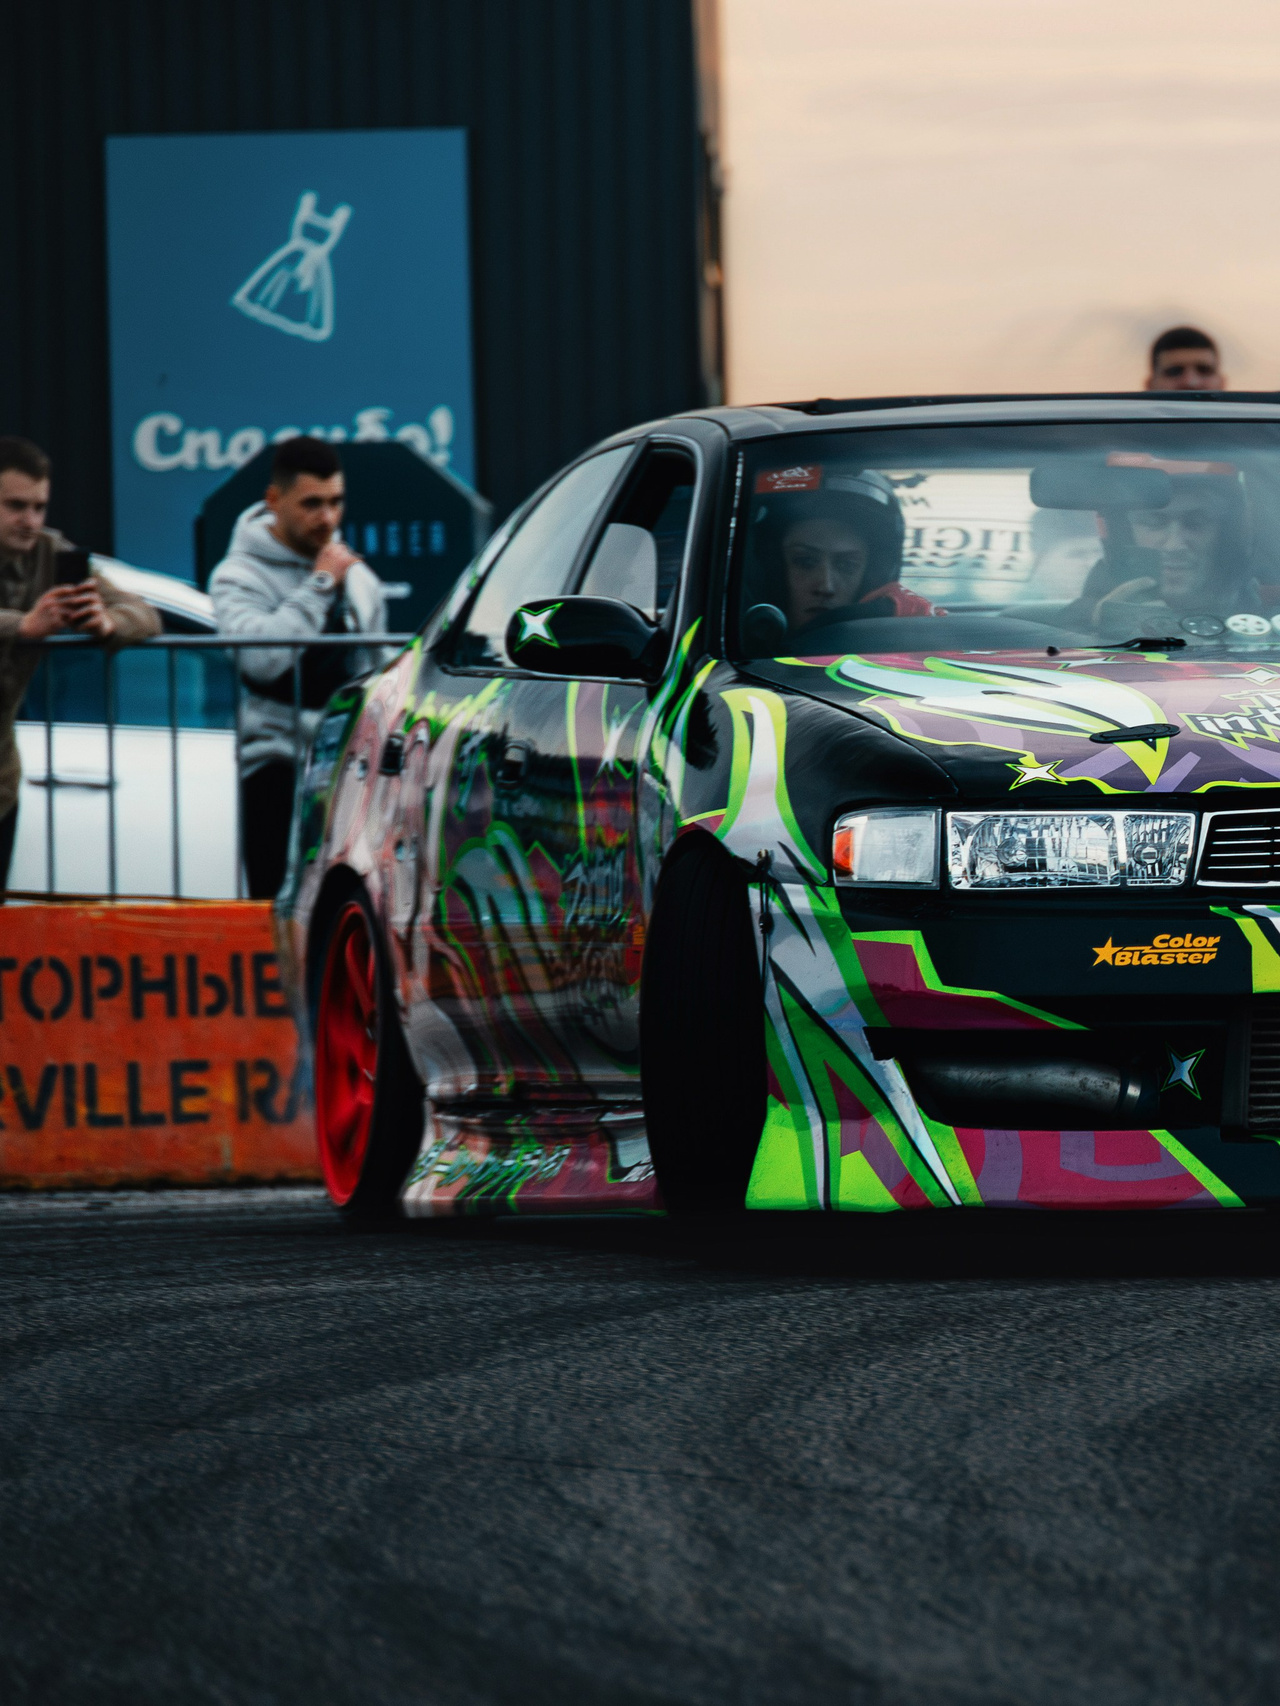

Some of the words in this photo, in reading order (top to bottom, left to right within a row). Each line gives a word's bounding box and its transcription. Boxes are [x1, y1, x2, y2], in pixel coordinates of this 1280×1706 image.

[133, 404, 455, 471] Спабо!
[1114, 951, 1217, 966] Blaster
[1152, 933, 1221, 948] Color
[0, 1059, 211, 1130] VILLE
